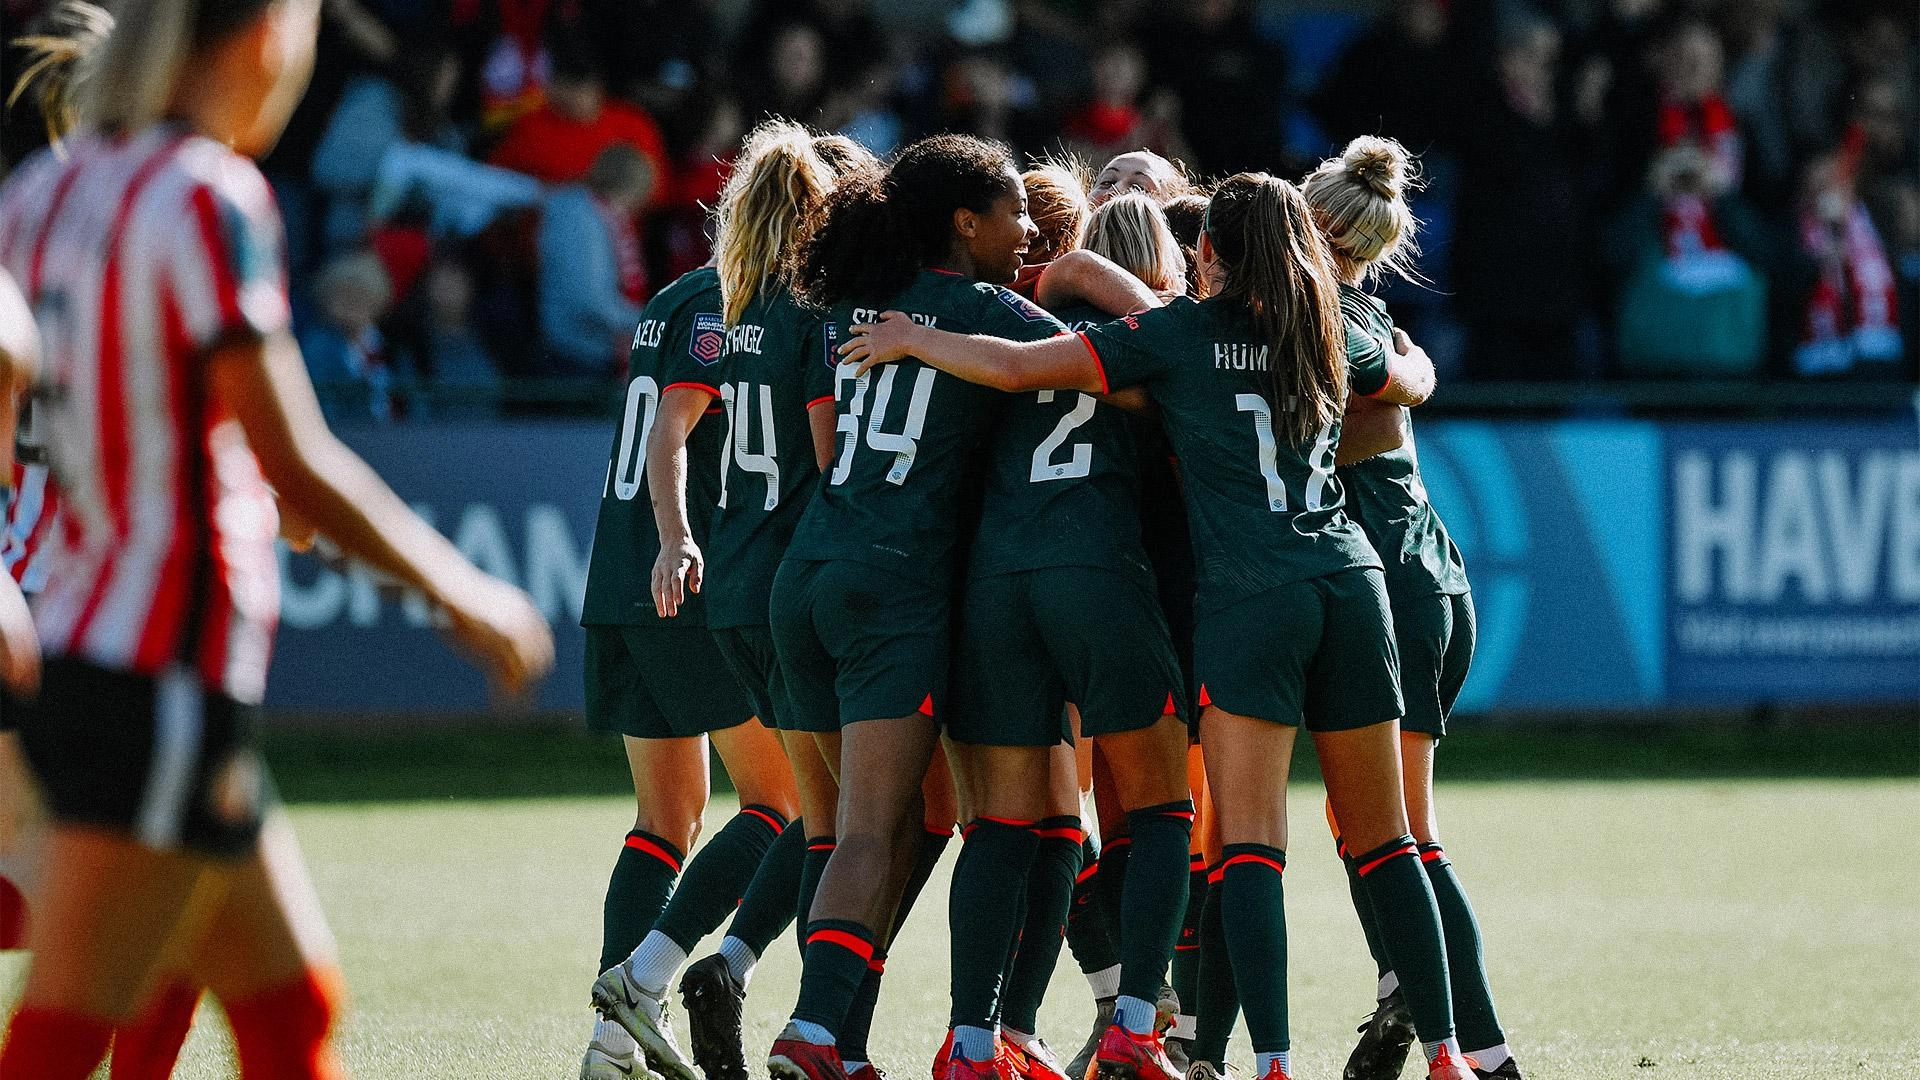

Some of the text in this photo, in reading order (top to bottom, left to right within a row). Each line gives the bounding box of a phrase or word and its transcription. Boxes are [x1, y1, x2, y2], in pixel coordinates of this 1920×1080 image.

[603, 376, 659, 500] 0
[831, 361, 937, 486] 34
[1029, 389, 1097, 483] 2
